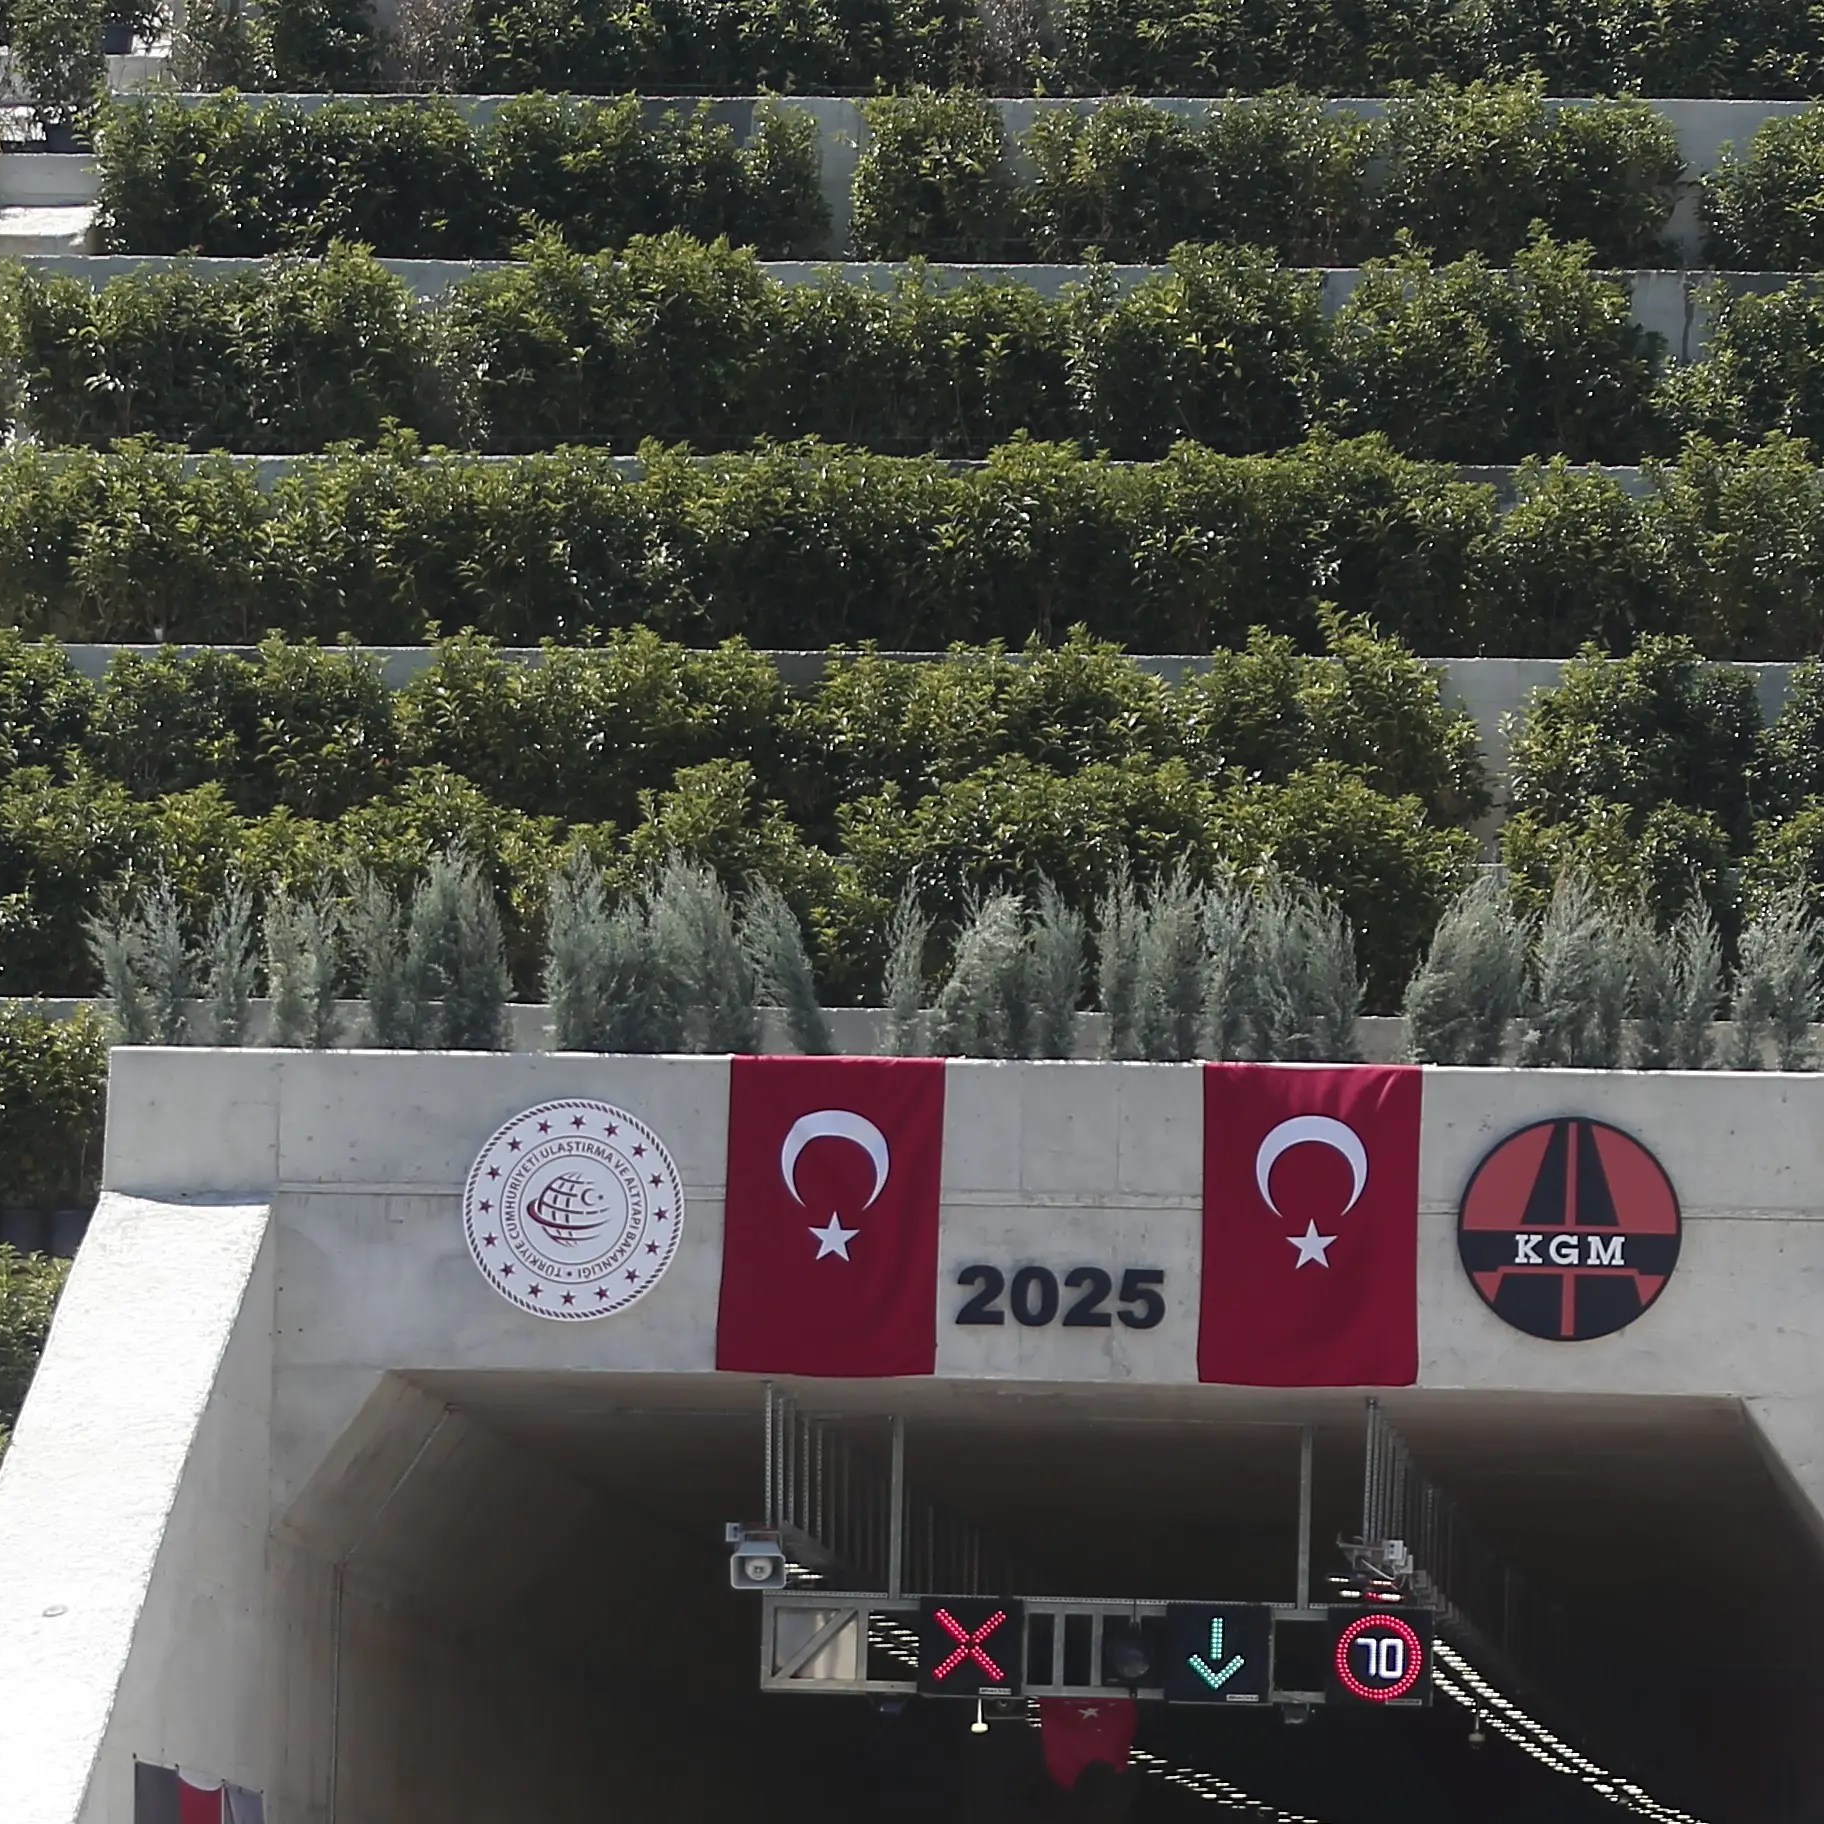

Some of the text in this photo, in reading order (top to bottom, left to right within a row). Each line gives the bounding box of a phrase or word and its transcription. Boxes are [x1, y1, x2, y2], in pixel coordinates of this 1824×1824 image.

[540, 1141, 614, 1164] ULAŞTIRMA
[615, 1159, 630, 1177] VE
[625, 1176, 642, 1230] ALTYAPI
[578, 1232, 637, 1278] BAKANLIĞI
[1515, 1234, 1625, 1265] KGM
[955, 1264, 1165, 1329] 2025
[1355, 1637, 1404, 1679] 70
